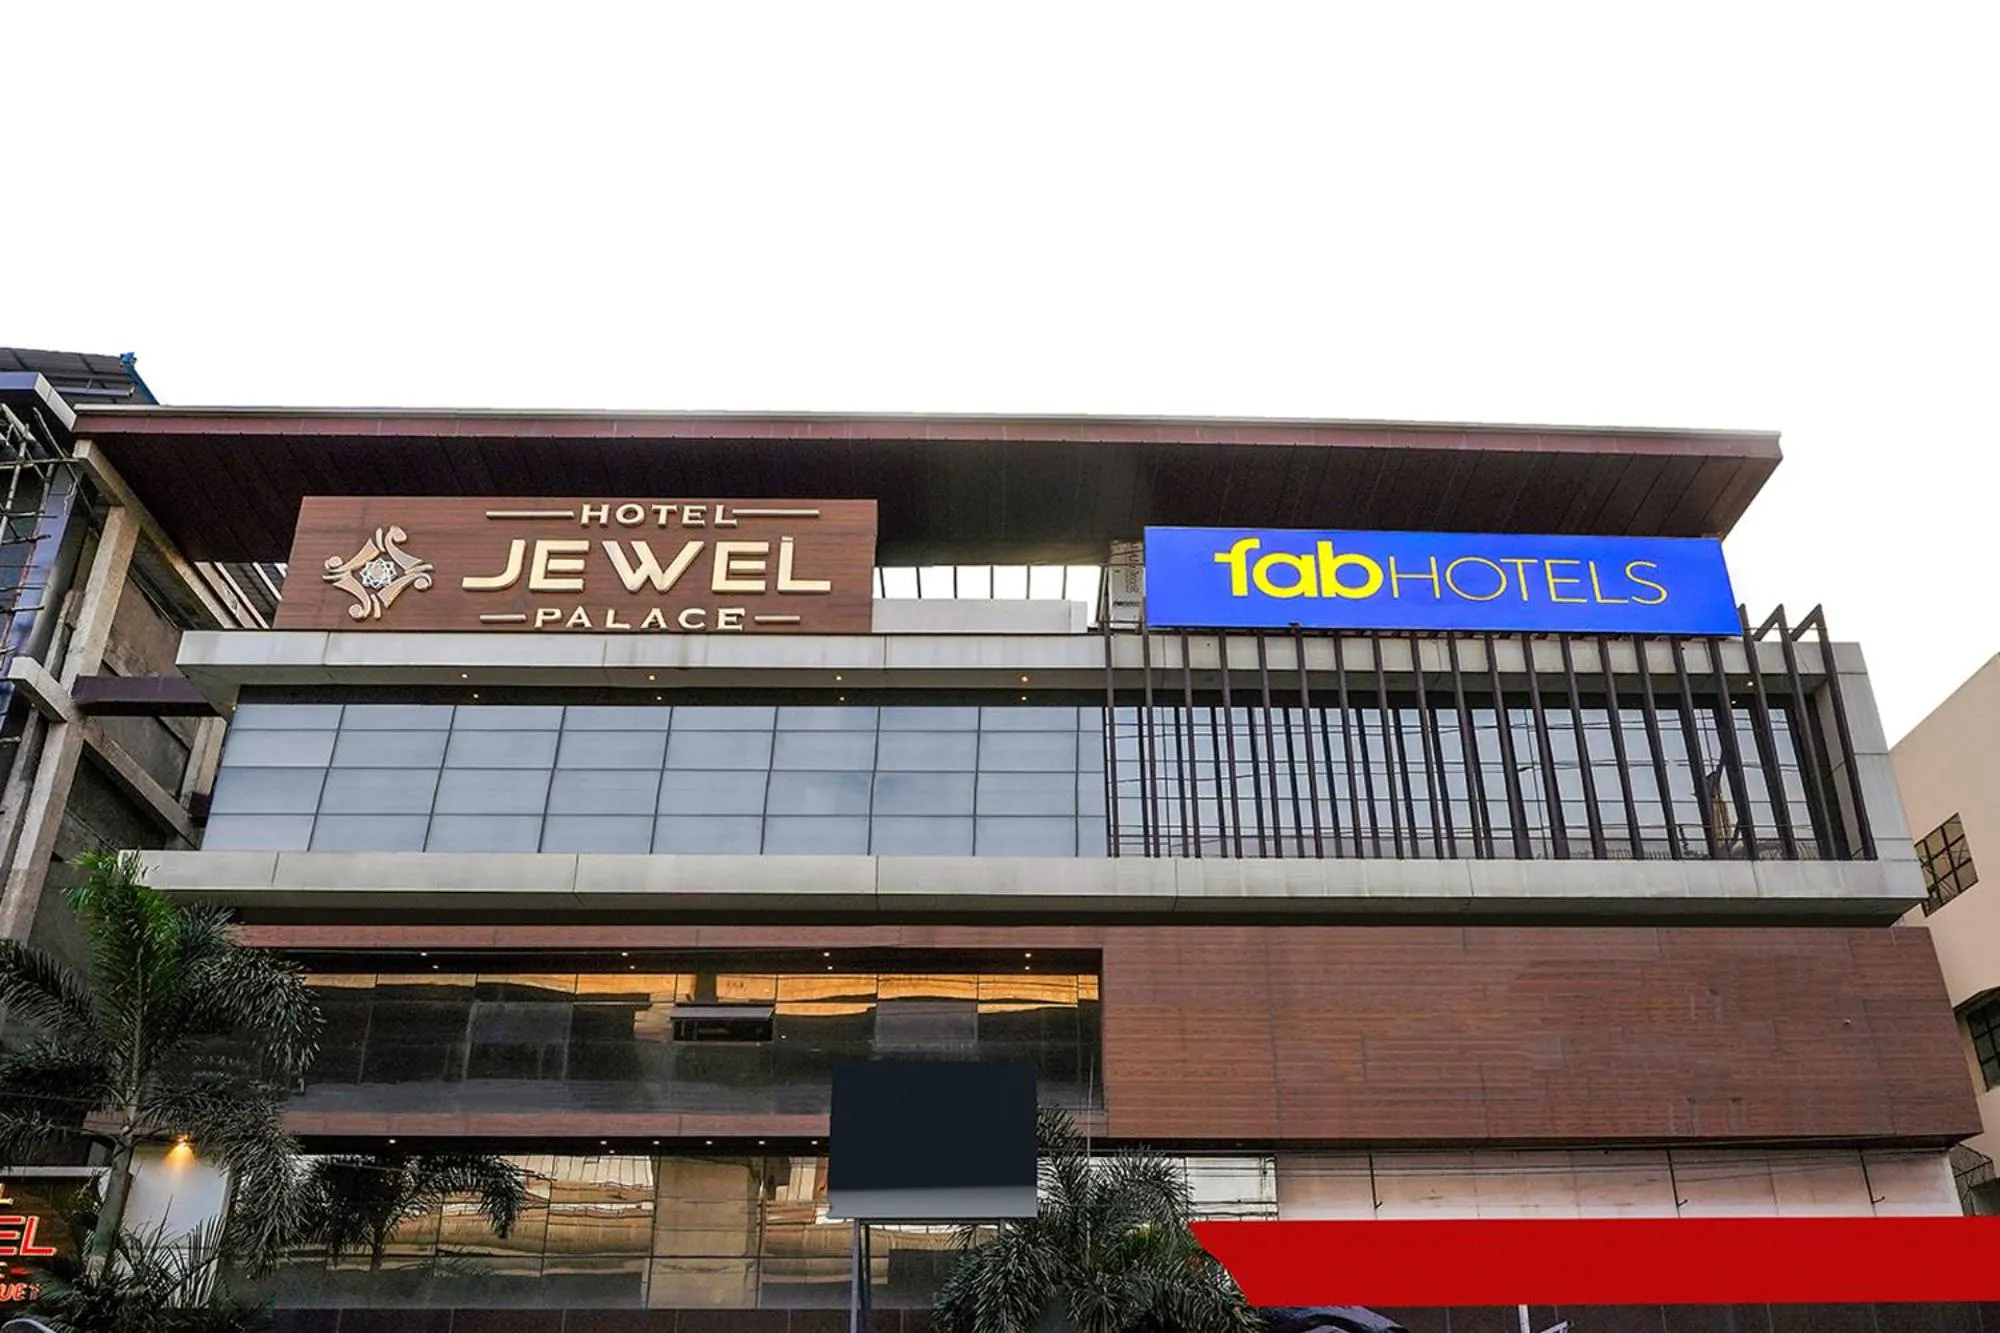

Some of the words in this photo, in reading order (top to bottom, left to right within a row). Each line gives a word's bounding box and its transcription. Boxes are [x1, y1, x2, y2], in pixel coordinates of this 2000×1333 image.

[579, 503, 739, 528] HOTEL
[461, 536, 832, 594] JEWEL
[533, 605, 747, 632] PALACE
